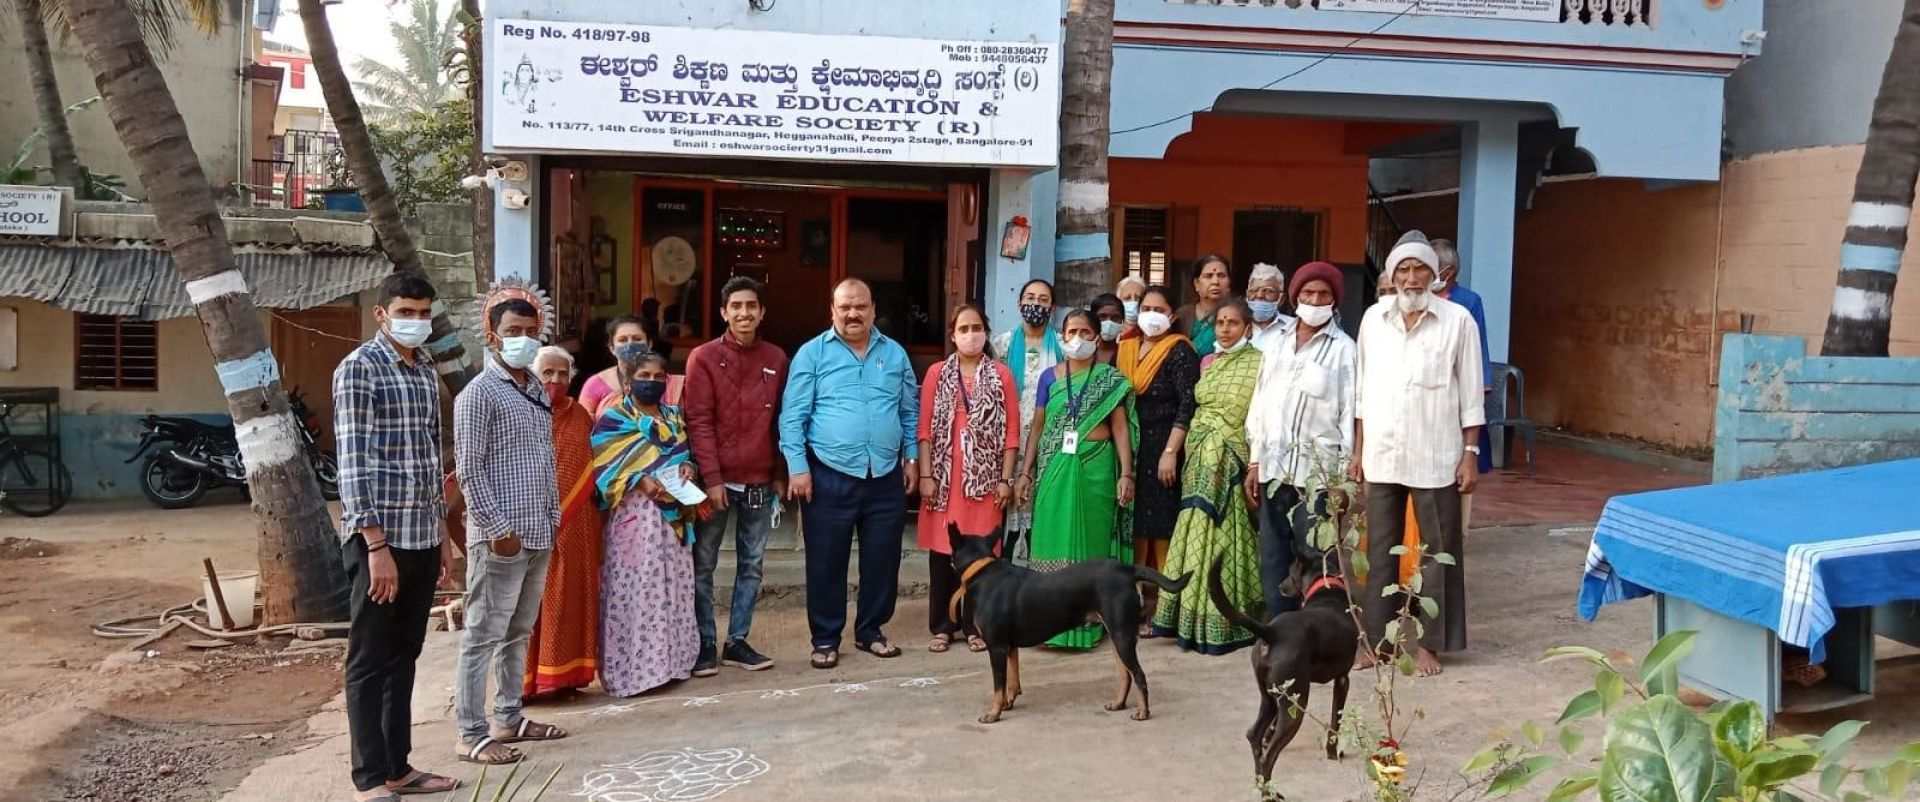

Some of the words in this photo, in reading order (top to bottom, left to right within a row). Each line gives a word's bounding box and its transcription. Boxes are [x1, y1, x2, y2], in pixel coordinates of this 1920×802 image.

[503, 24, 535, 40] Reg
[540, 26, 567, 39] No.
[572, 28, 651, 43] 418/97-98
[941, 44, 953, 53] Ph
[957, 45, 971, 53] Off
[949, 53, 972, 62] Mob
[580, 54, 658, 87] ಈಶ್ವರ್
[673, 54, 728, 89] ಶಿಕ್ಷಣ
[742, 62, 798, 93] ಮತ್ತು
[811, 58, 942, 99] ಕ್ಷೇಮಾಭಿವೃದ್ಧಿ
[619, 88, 759, 108] ESHWAR
[776, 95, 960, 115] EDUCATION
[978, 101, 998, 116] &
[643, 110, 783, 127] WELFARE
[796, 117, 920, 132] SOCIETY
[522, 120, 543, 129] No.
[599, 124, 625, 133] 14th
[630, 126, 665, 134] Cross
[670, 127, 770, 140] Srigandhanagar,
[774, 131, 858, 143] Hegganahalli,
[862, 135, 904, 144] Peenya
[956, 137, 1033, 147] Bangalore-91
[673, 139, 708, 148] Email
